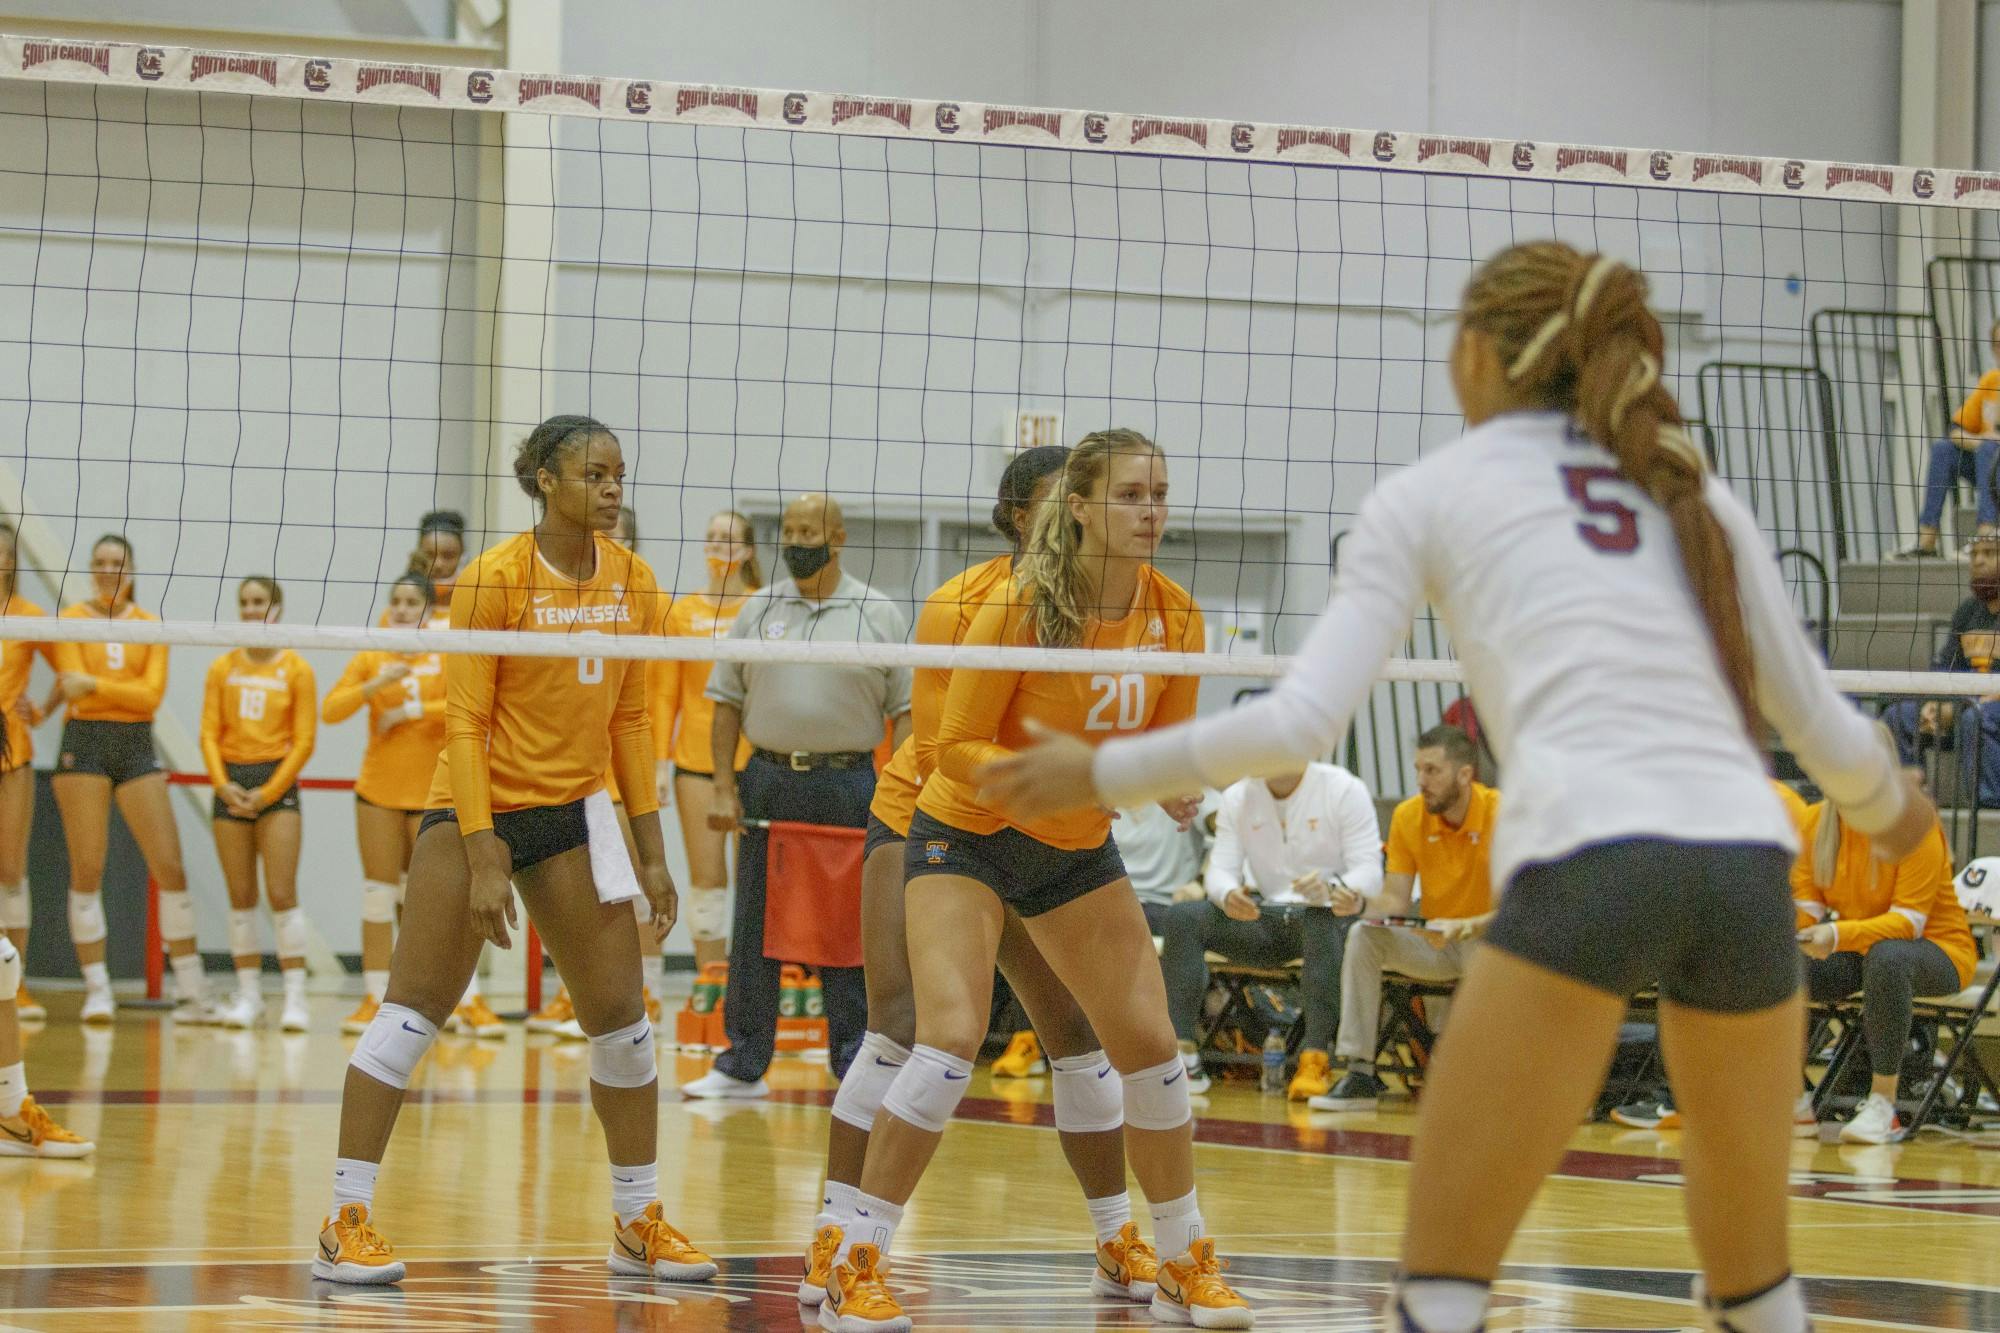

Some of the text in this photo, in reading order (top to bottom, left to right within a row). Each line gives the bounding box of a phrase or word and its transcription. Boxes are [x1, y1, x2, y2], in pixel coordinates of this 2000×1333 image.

[22, 42, 109, 76] SOUTH CAROLINA
[190, 55, 277, 87] SOUTH CAROLINA
[356, 67, 440, 100] SOUTH CAROLINA
[519, 79, 601, 110] SOUTH CAROLINA
[676, 89, 757, 120] SOUTH CAROLINA
[832, 100, 912, 130] SOUTH CAROLINA
[983, 110, 1061, 140] SOUTH CAROLINA
[1131, 119, 1207, 150] SOUTH CAROLINA
[1277, 129, 1351, 158] SOUTH CAROLINA
[1418, 138, 1491, 168] SOUTH CAROLINA
[1556, 148, 1627, 177] SOUTH CAROLINA
[1692, 158, 1762, 186] SOUTH CAROLINA
[1825, 167, 1893, 196] SOUTH CAROLINA
[1954, 176, 1981, 200] SOUTH
[1020, 415, 1057, 447] EXIT
[1558, 464, 1640, 554] 5
[533, 604, 630, 625] TENNESSEE
[402, 677, 422, 717] 3
[1084, 672, 1145, 731] 20
